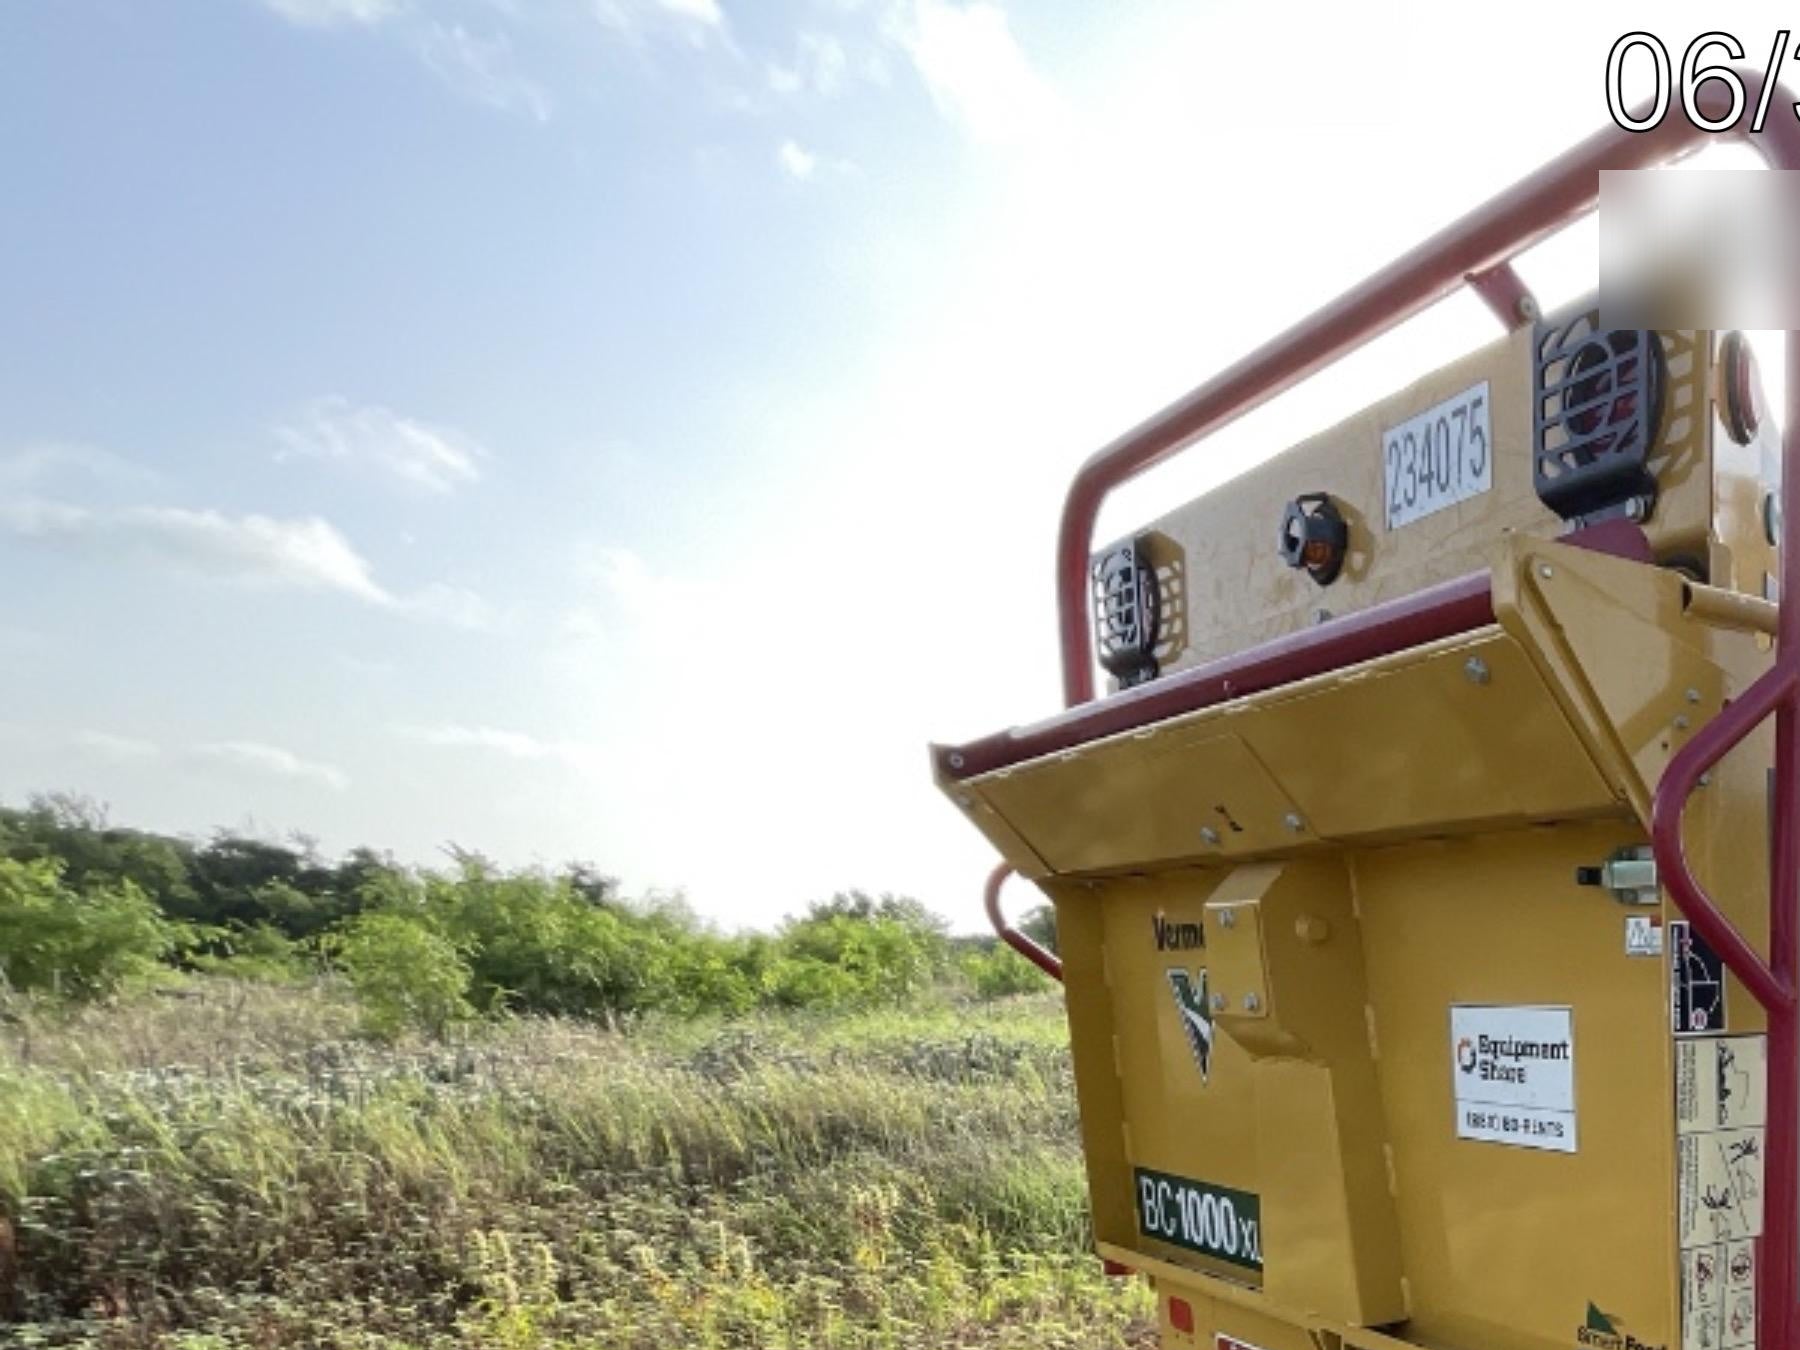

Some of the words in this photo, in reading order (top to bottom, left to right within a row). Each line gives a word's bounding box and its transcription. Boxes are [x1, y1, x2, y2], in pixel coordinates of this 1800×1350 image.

[1388, 396, 1485, 513] 234075
[1151, 912, 1207, 951] Verm
[1478, 1034, 1570, 1062] Equipment
